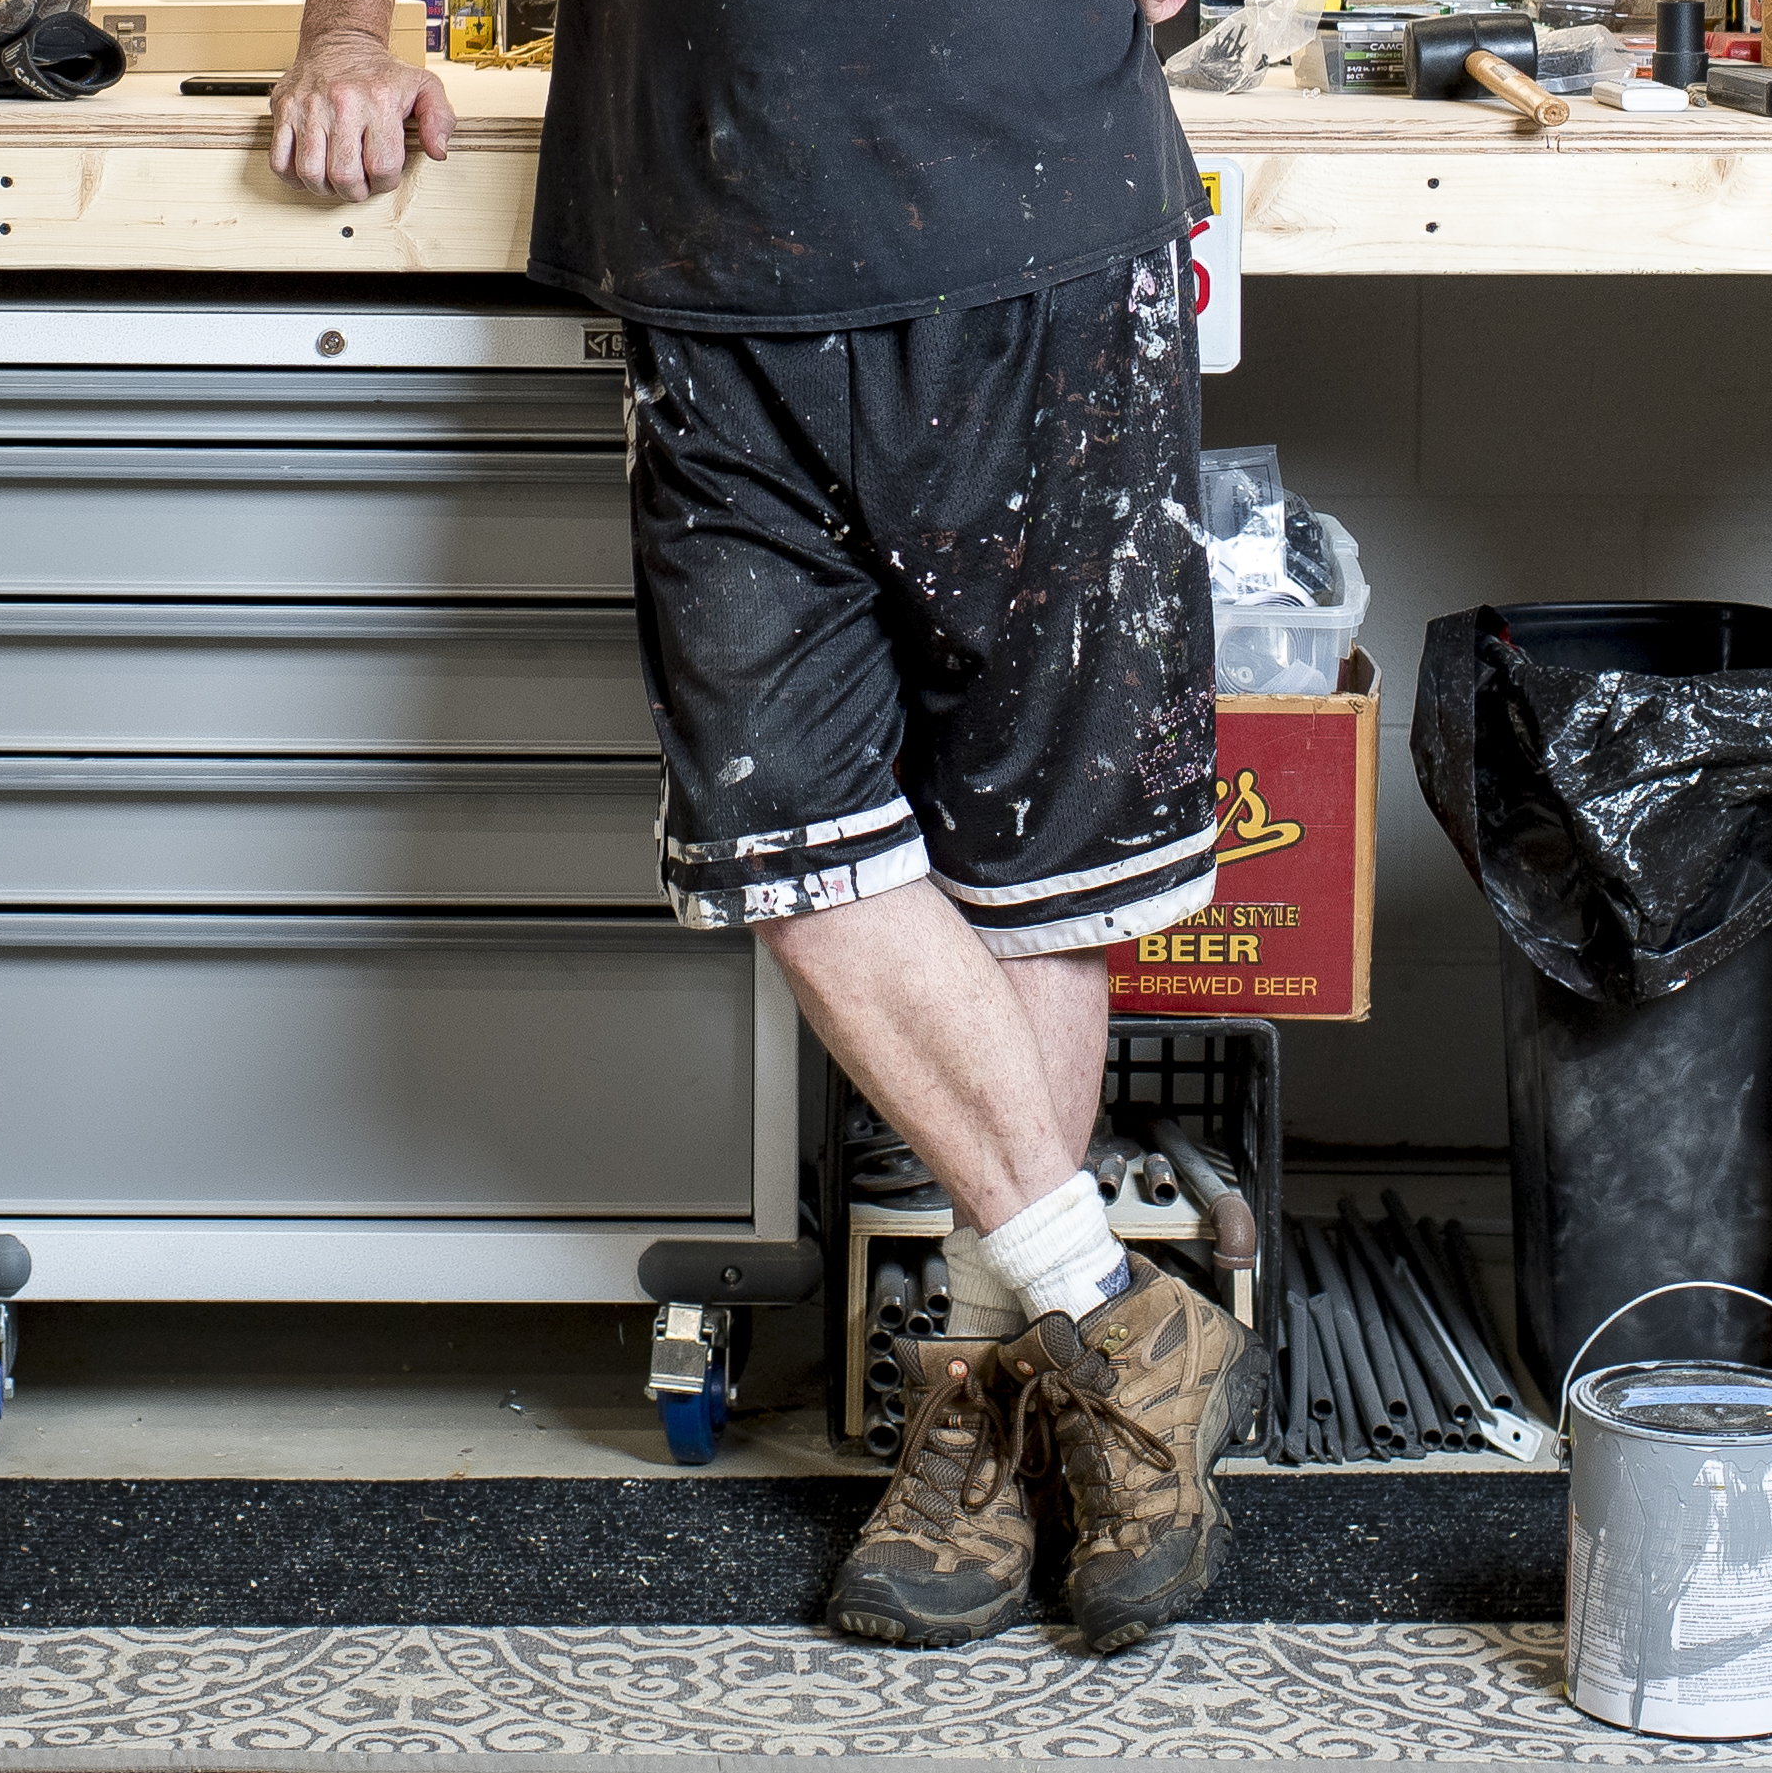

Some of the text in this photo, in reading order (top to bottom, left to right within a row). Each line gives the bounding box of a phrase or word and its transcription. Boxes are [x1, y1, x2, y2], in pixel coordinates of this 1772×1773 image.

[1233, 906, 1300, 927] STYLE
[1138, 934, 1261, 964] BEER
[1254, 977, 1318, 996] BEER
